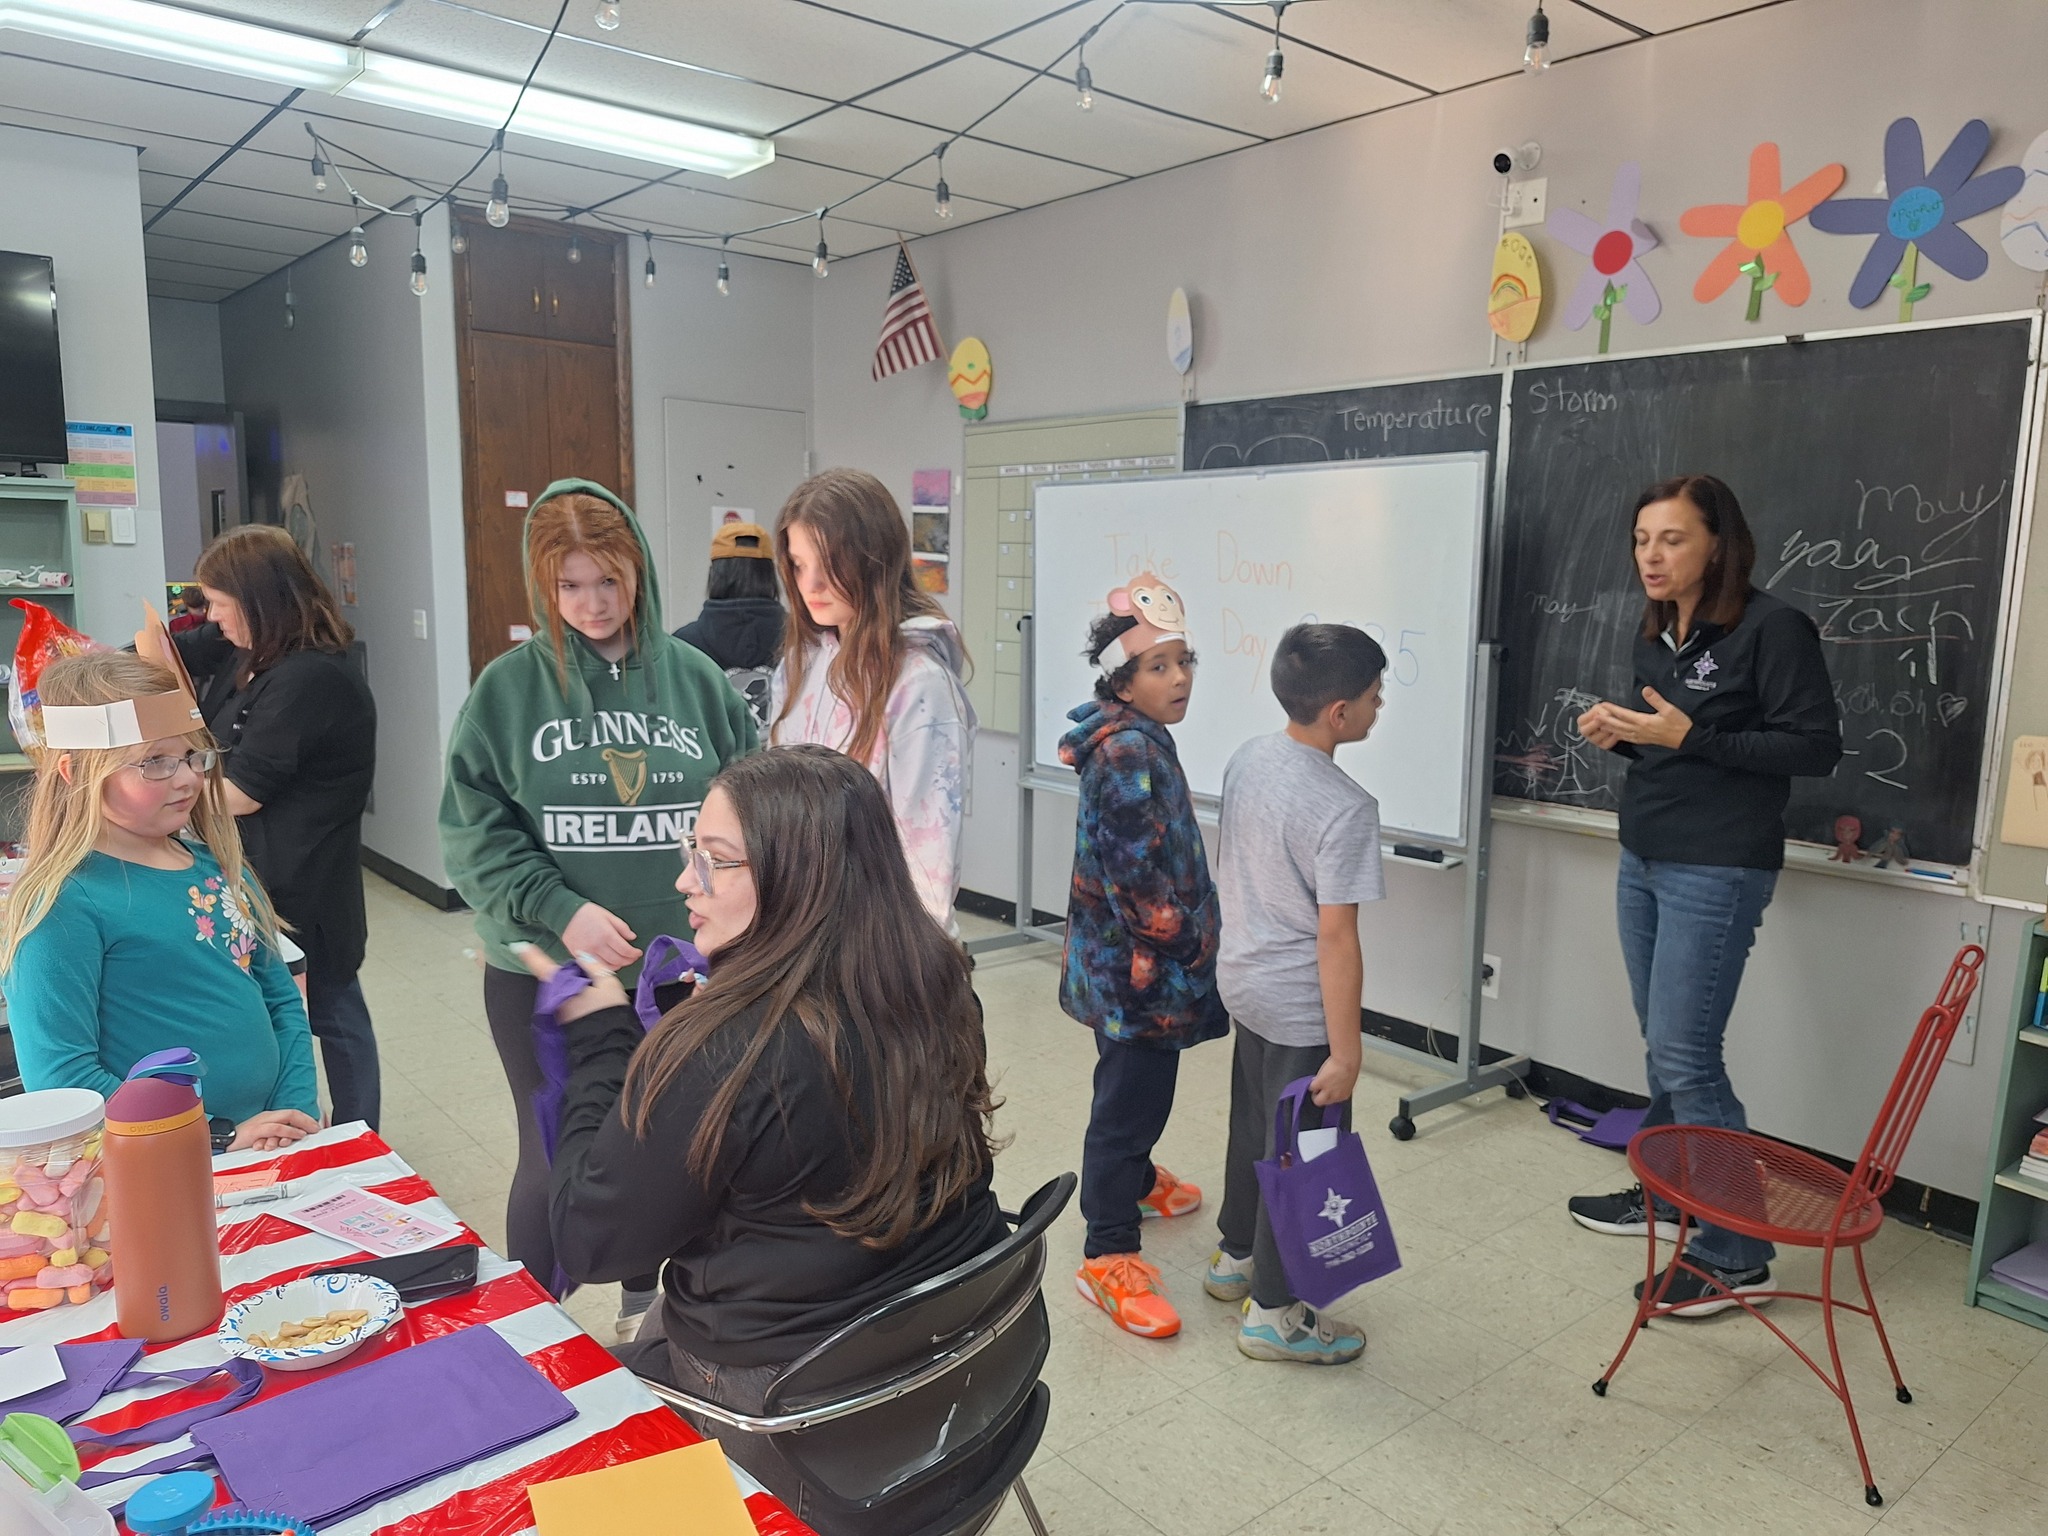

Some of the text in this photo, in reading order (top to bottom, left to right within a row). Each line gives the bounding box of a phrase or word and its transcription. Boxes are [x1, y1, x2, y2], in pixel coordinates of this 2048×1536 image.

[1528, 377, 1618, 414] Storm
[1334, 399, 1493, 441] Temperature
[1103, 530, 1295, 590] Take Down
[1222, 608, 1268, 694] Day
[532, 710, 703, 762] GUINNESS
[652, 771, 684, 784] 1759
[156, 1284, 170, 1322] owala
